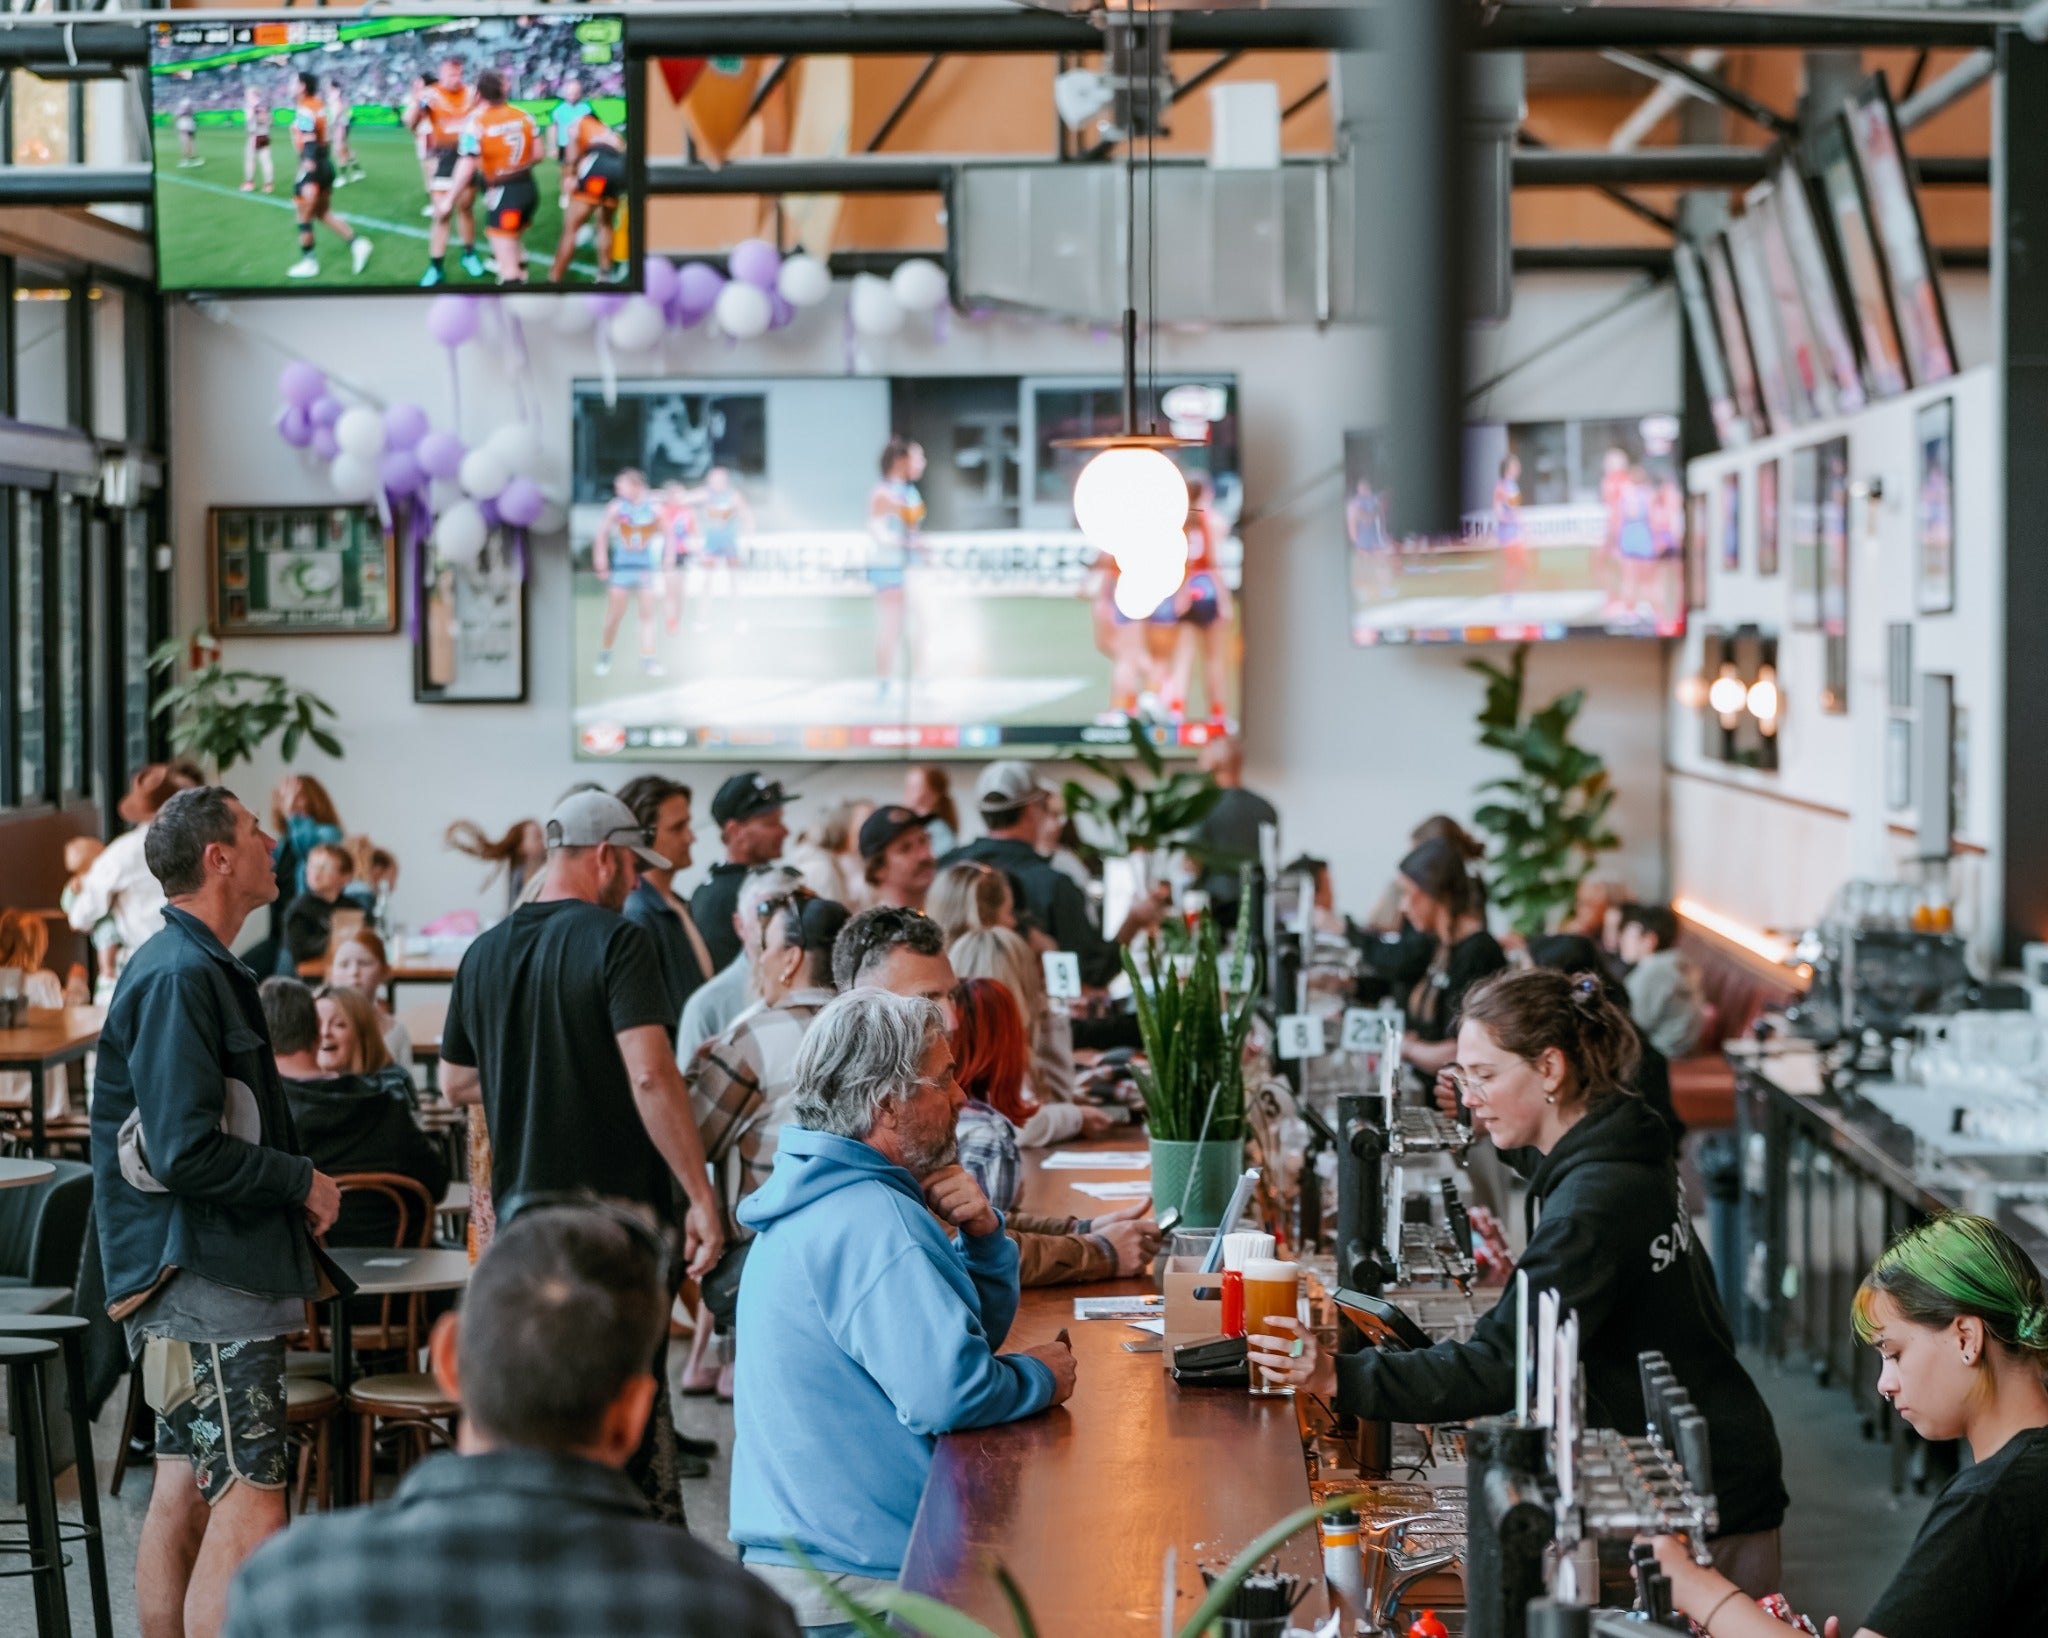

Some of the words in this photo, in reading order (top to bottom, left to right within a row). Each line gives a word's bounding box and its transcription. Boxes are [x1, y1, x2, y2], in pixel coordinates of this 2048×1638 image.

[503, 133, 525, 166] 7
[747, 546, 870, 584] MINERA
[1260, 1090, 1282, 1119] 3
